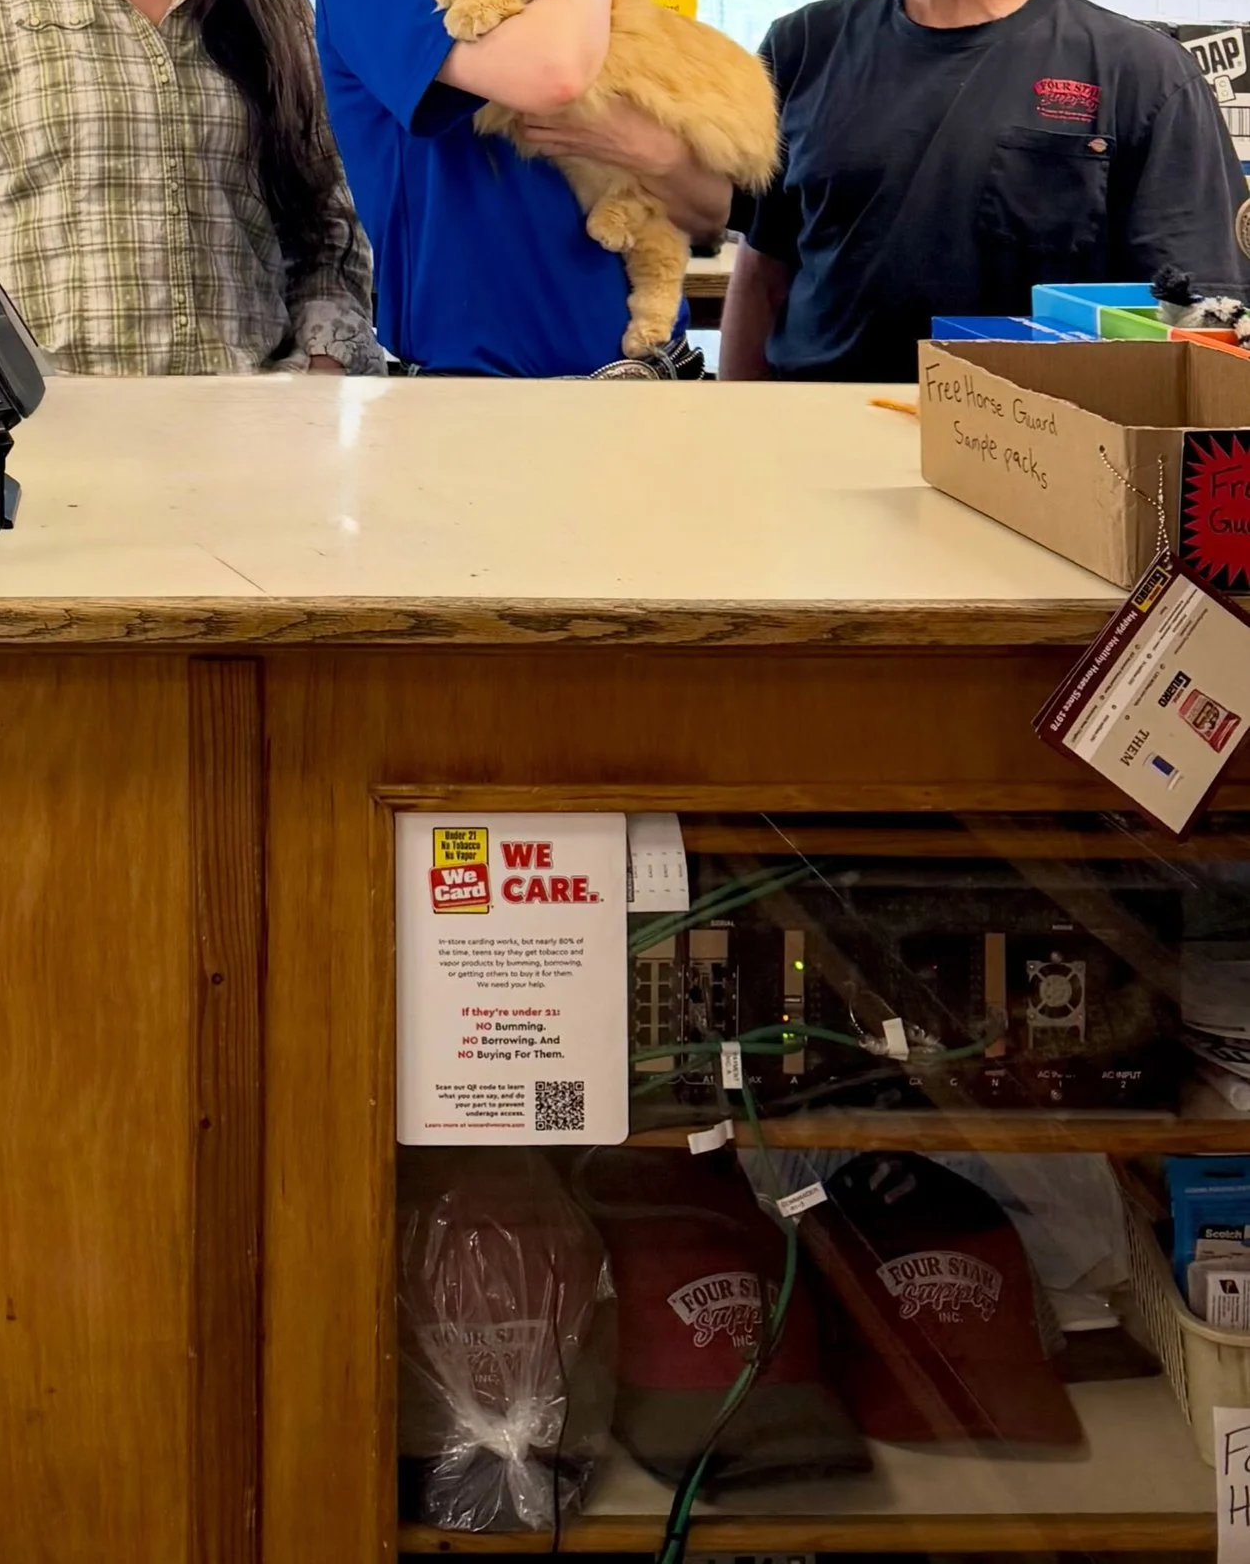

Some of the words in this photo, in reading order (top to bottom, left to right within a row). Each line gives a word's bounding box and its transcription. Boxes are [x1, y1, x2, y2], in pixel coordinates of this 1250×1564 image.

[1191, 37, 1241, 76] DAP
[1040, 80, 1071, 91] FOUR
[925, 363, 962, 403] Free
[963, 374, 1005, 417] Horse
[1012, 398, 1058, 436] Guard
[1003, 447, 1048, 490] packs
[1115, 610, 1138, 636] Happy,
[1094, 636, 1120, 666] Healthy
[1078, 663, 1100, 693] Horses
[1063, 690, 1082, 713] Since
[1119, 728, 1150, 767] THEM
[501, 841, 553, 869] WE
[441, 868, 478, 885] We
[502, 876, 600, 904] CARE.
[434, 882, 487, 901] Card
[461, 1007, 470, 1016] If
[472, 1007, 509, 1018] they're
[512, 1007, 542, 1016] under
[545, 1008, 561, 1017] 21:
[475, 1022, 492, 1031] NO
[495, 1022, 546, 1032] Bumming.
[462, 1036, 478, 1045] NO
[481, 1036, 537, 1047] Borrowing.
[540, 1035, 561, 1045] And
[458, 1050, 474, 1059] NO
[477, 1050, 512, 1061] Buying
[515, 1050, 531, 1059] For
[533, 1050, 565, 1059] Them.
[1204, 1228, 1243, 1240] Scotch
[889, 1256, 942, 1286] FOUR
[948, 1258, 997, 1288] STAR
[680, 1281, 734, 1313] FOUR
[900, 1282, 997, 1322] Supply
[938, 1311, 964, 1324] INC.
